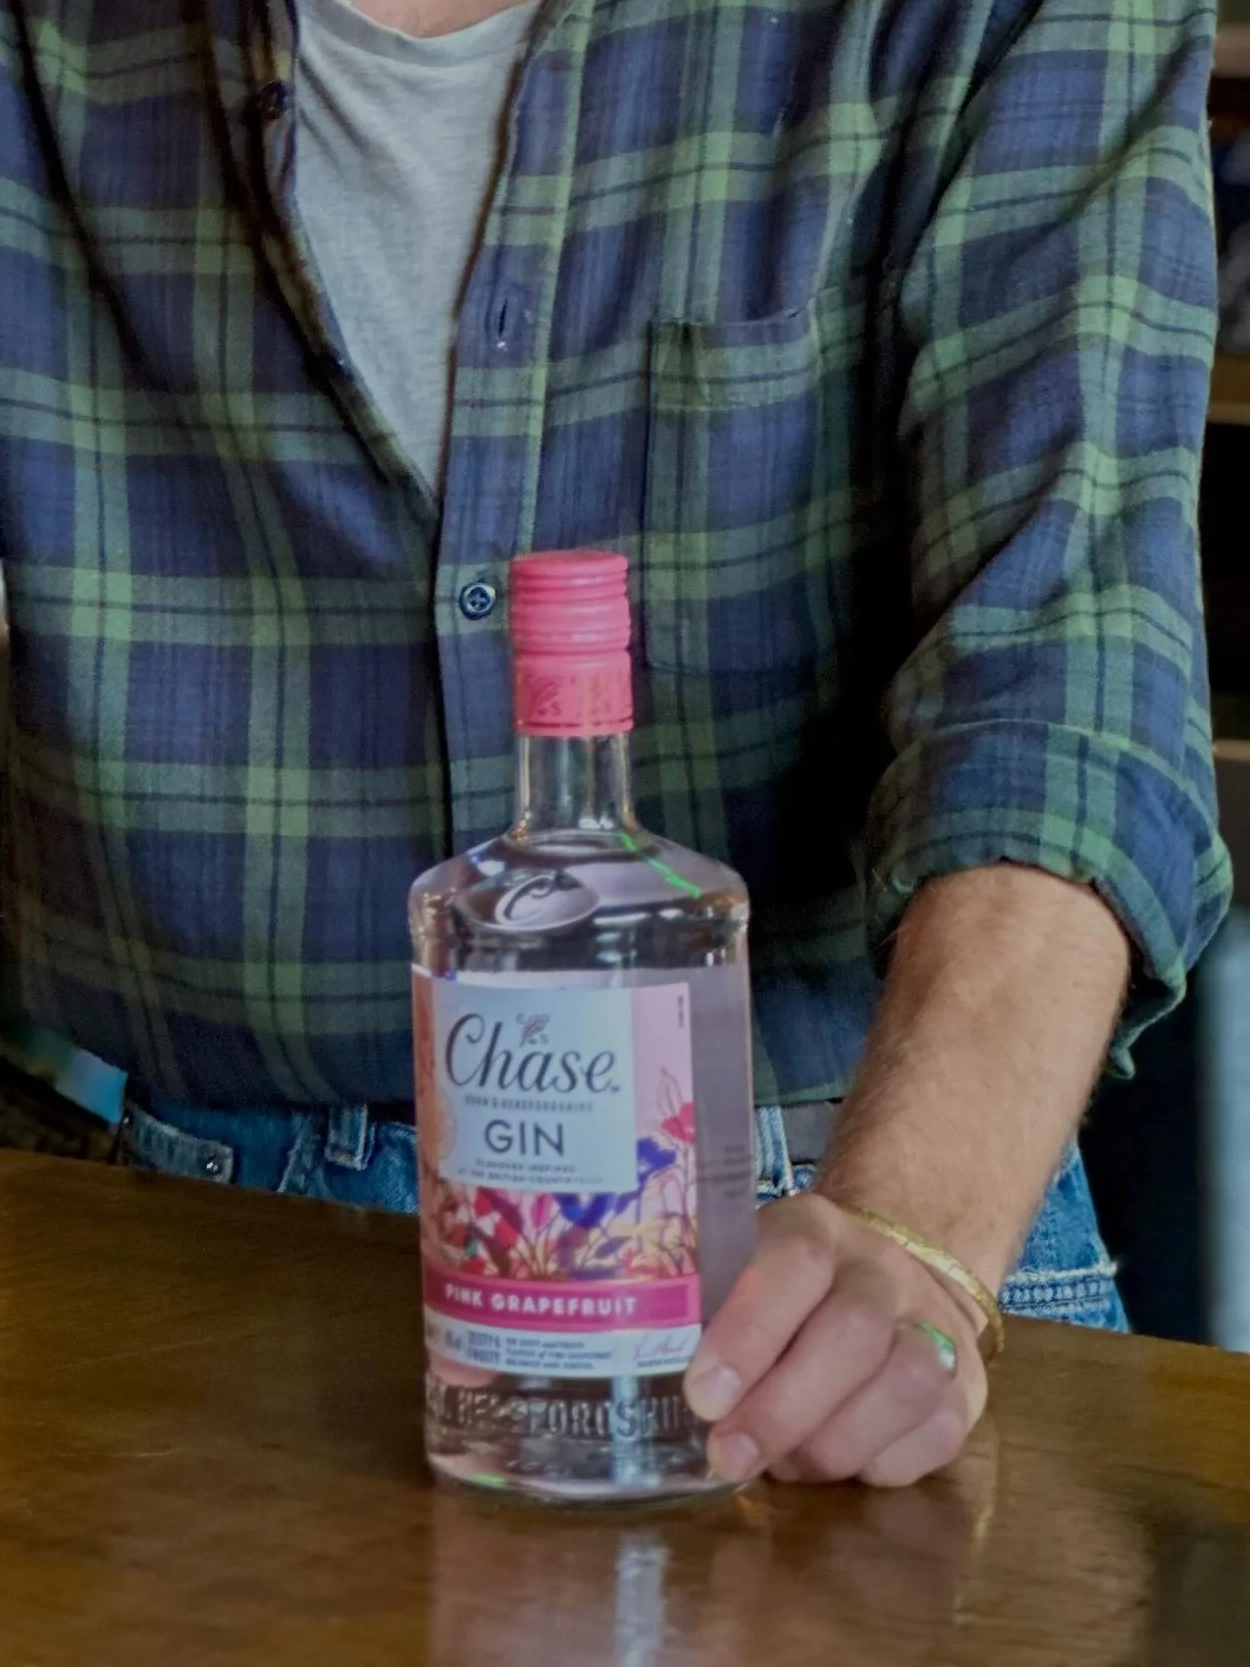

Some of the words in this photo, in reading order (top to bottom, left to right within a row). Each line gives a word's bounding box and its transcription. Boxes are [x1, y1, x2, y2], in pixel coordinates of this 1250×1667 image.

[445, 1013, 616, 1093] Chase
[484, 1119, 564, 1157] GIN
[445, 1284, 483, 1307] PINK
[491, 1293, 637, 1316] GRAPEFRUIT
